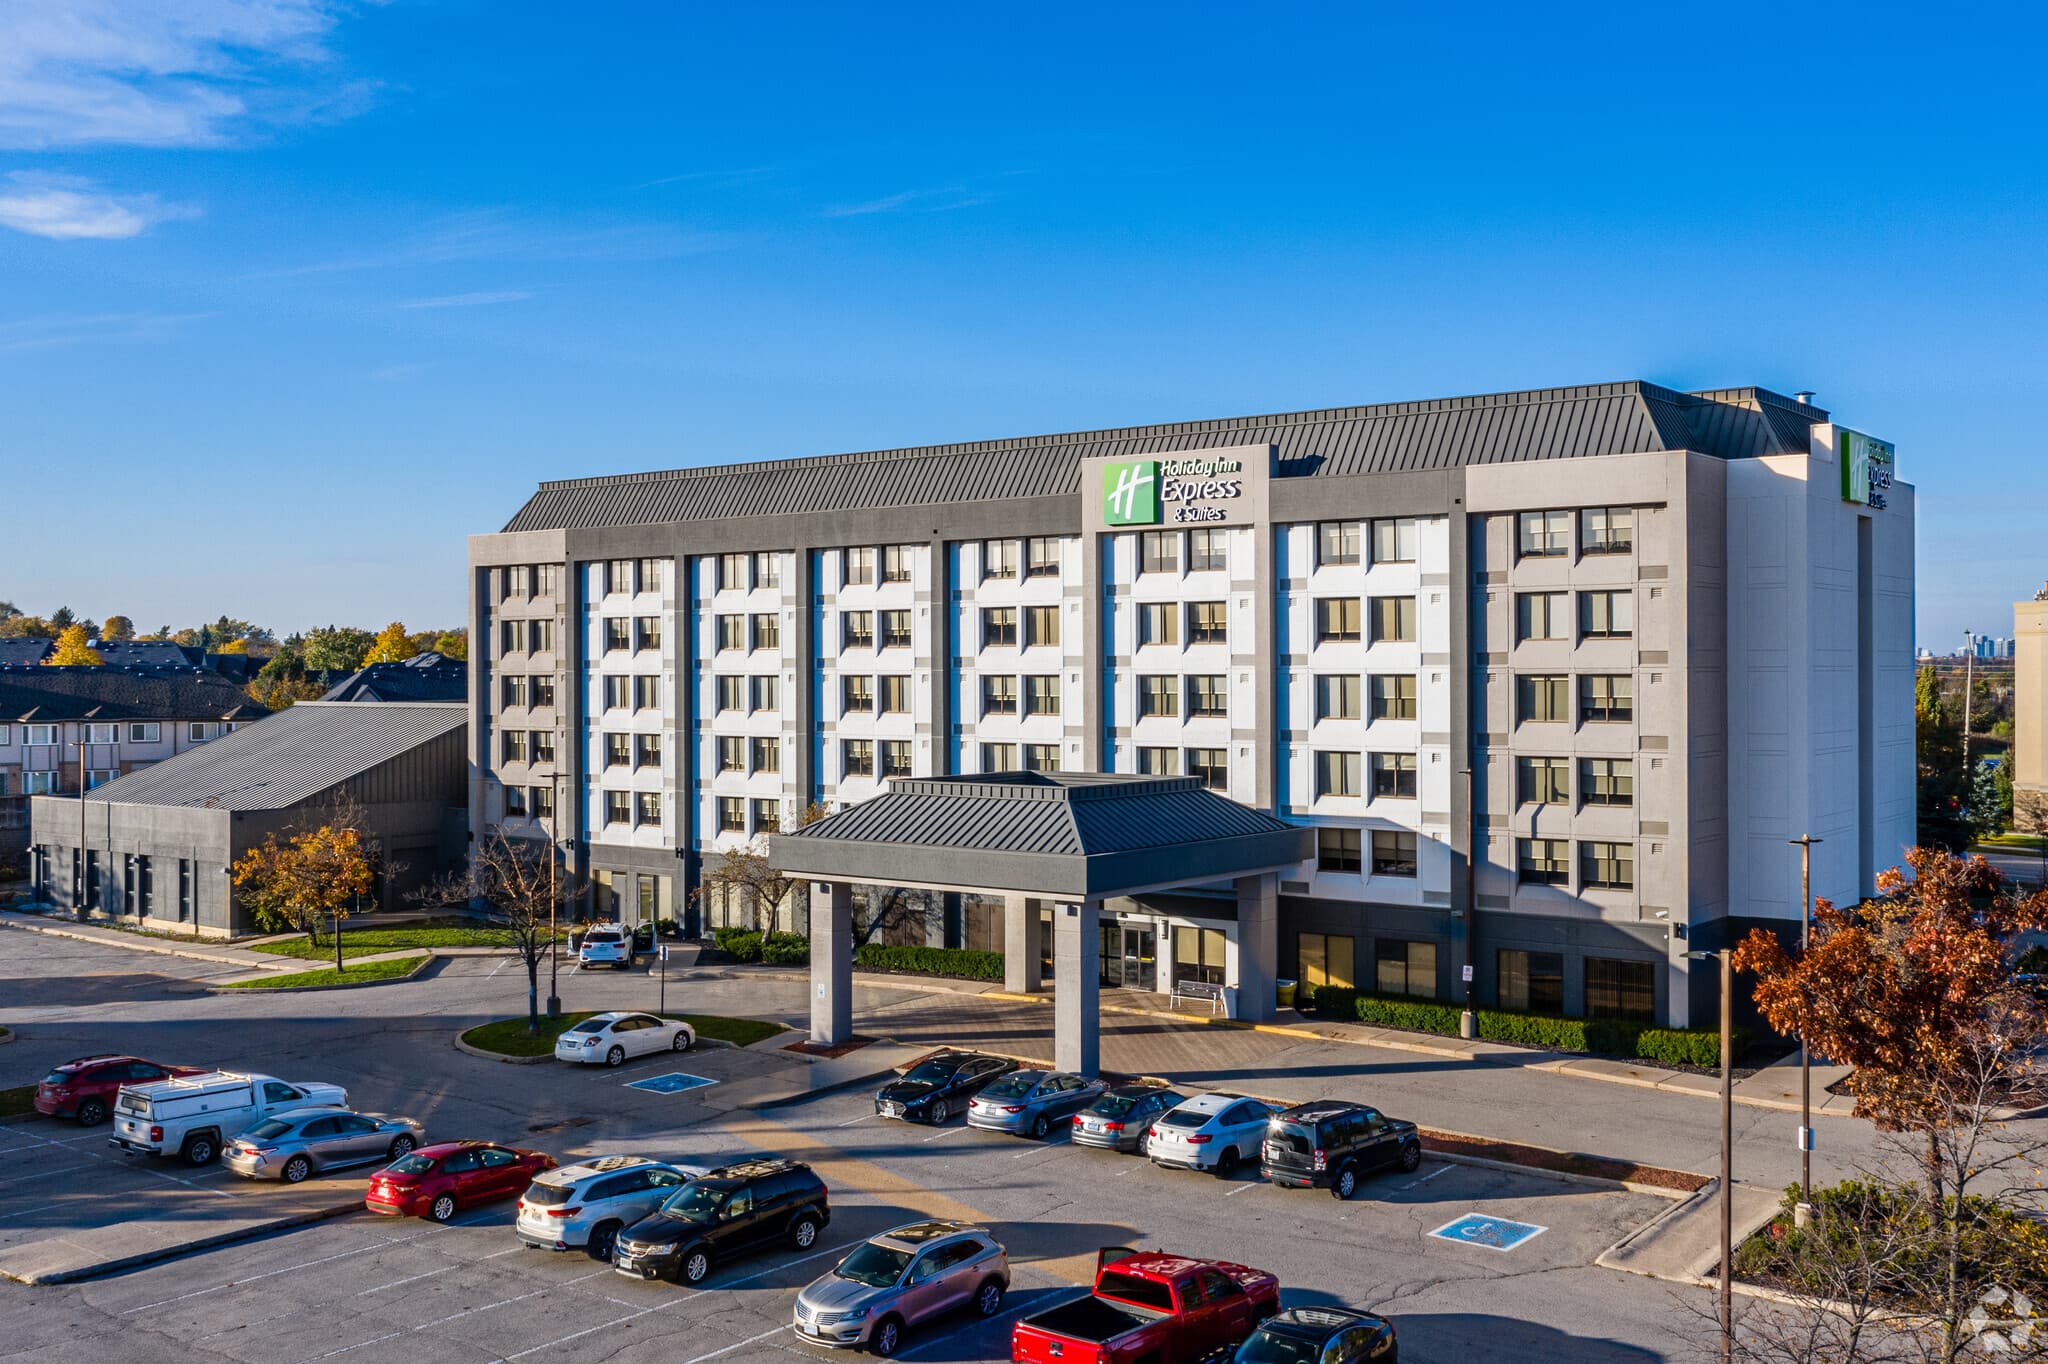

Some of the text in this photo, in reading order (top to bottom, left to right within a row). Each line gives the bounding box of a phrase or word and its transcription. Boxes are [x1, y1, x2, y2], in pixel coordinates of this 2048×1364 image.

[1160, 456, 1238, 477] Holiday Inn
[1160, 478, 1238, 505] Express
[1174, 506, 1223, 522] & Suites
